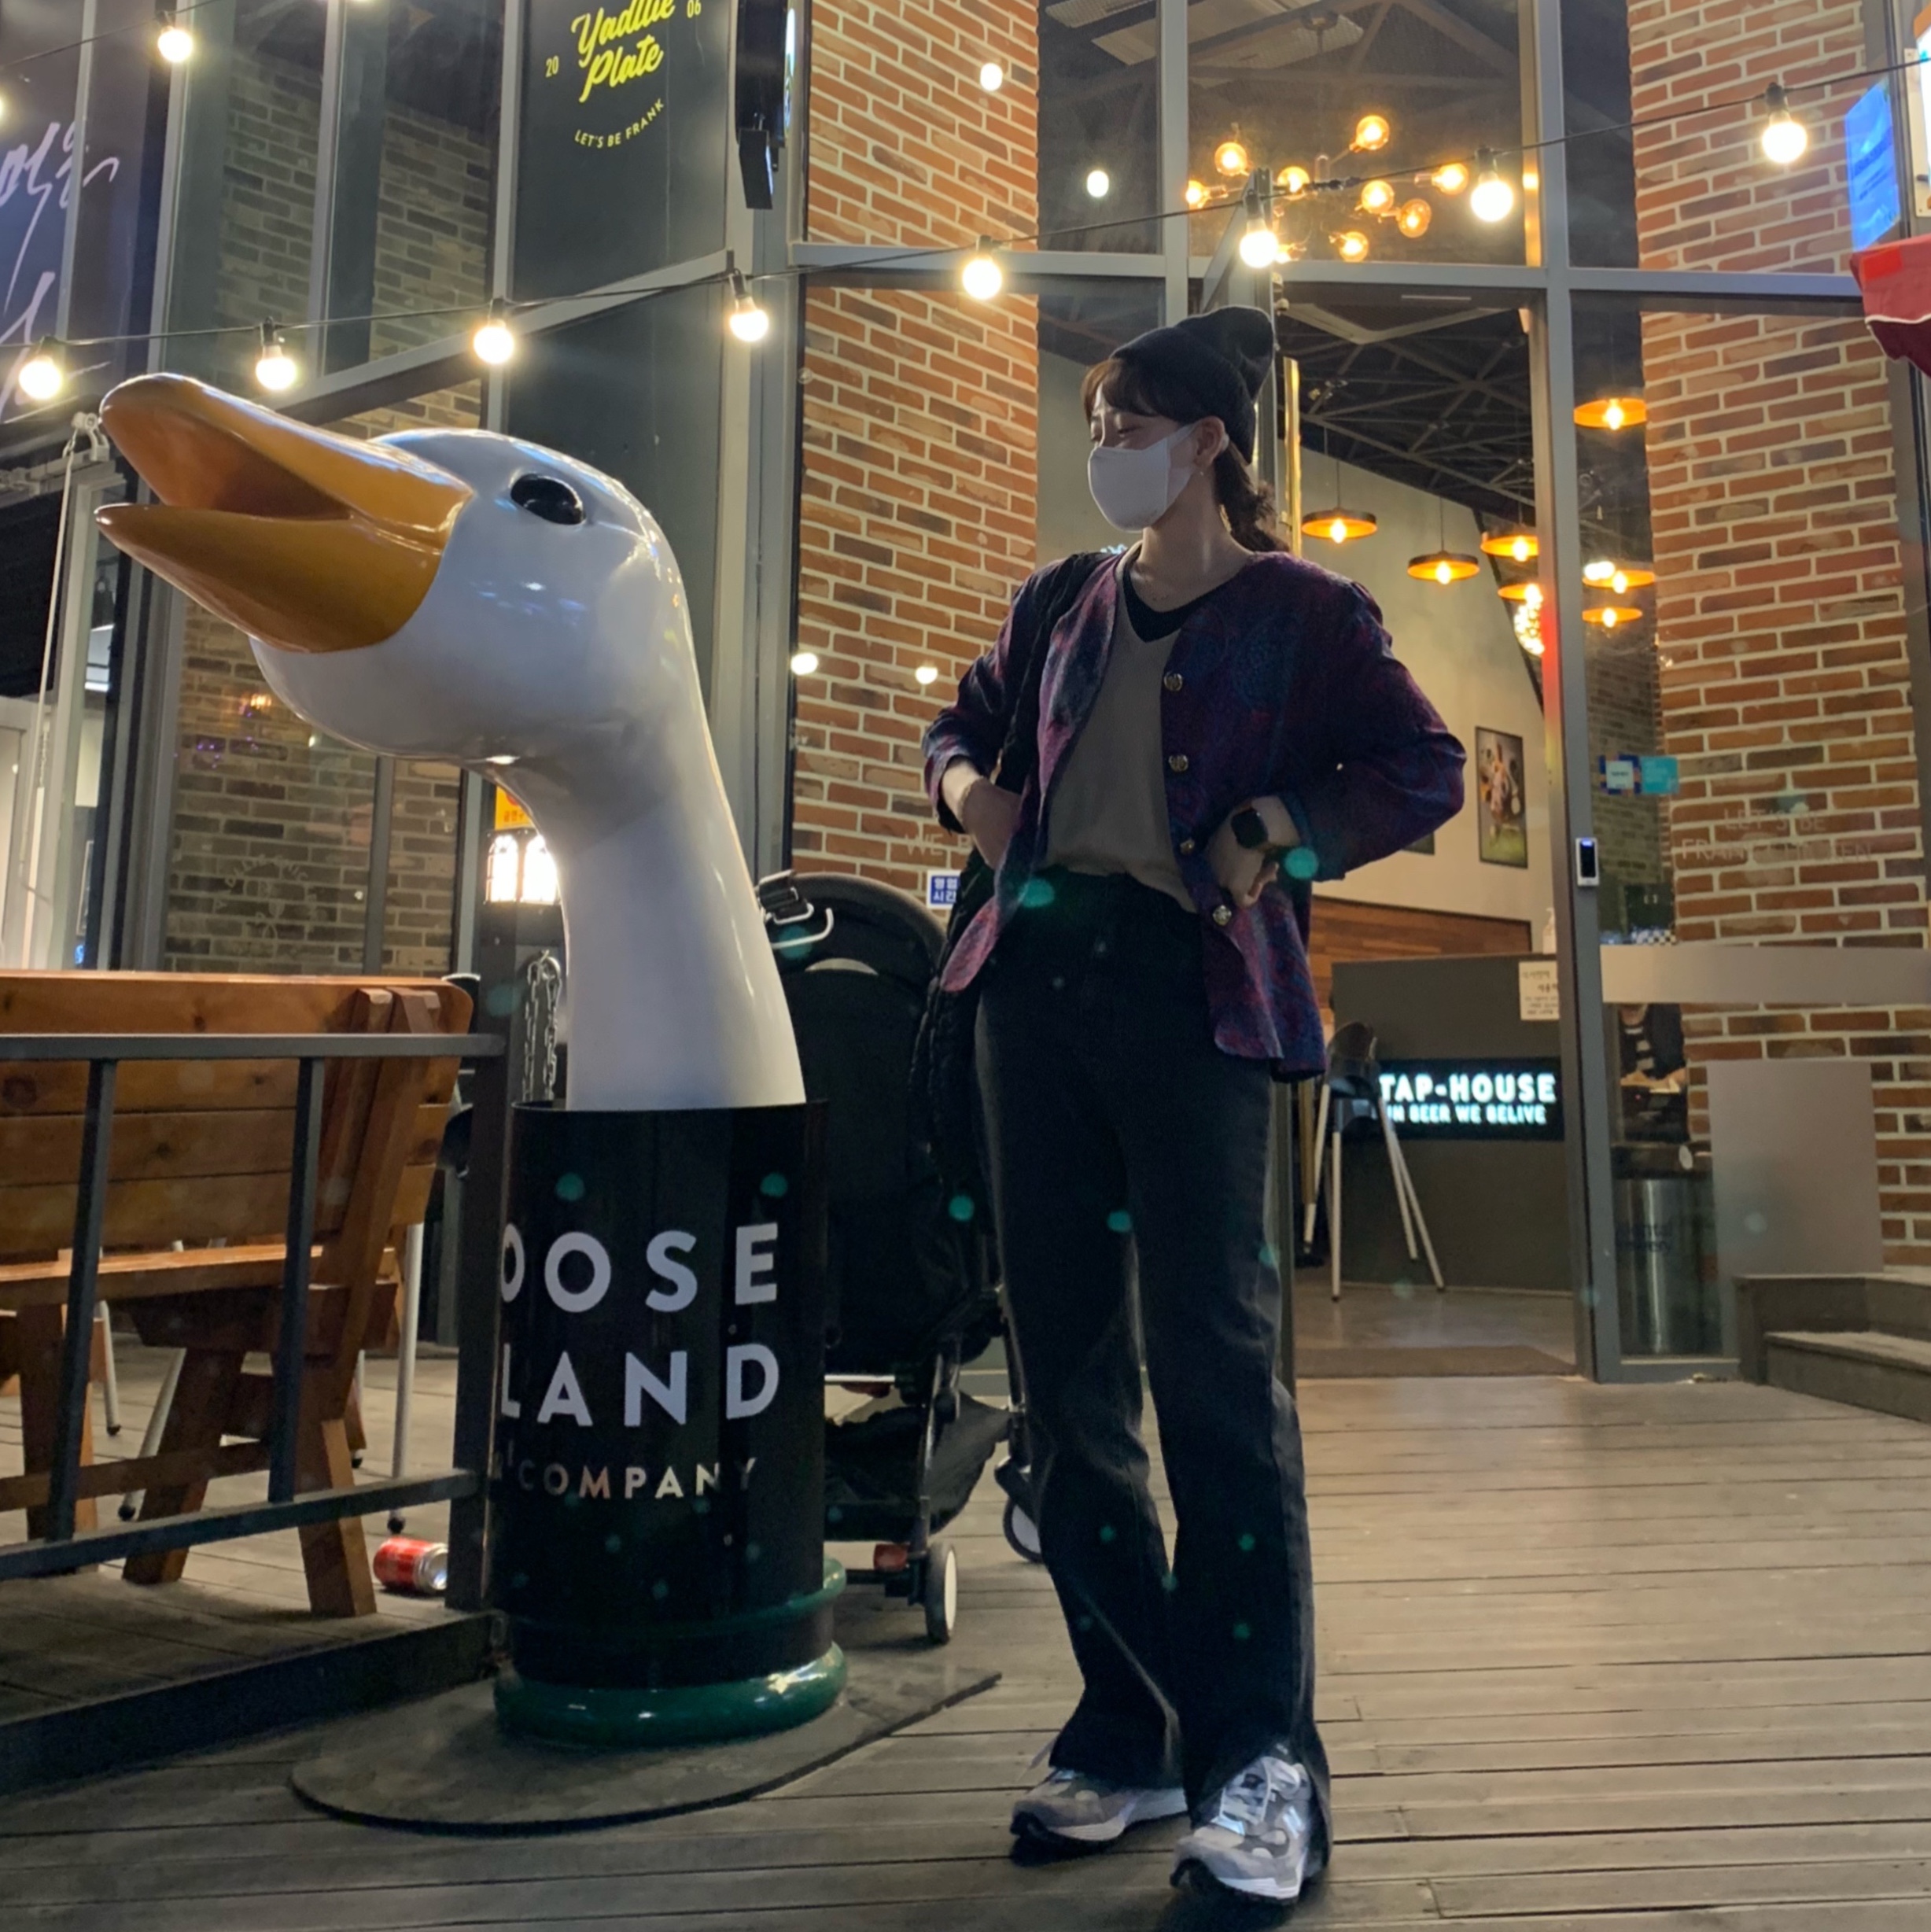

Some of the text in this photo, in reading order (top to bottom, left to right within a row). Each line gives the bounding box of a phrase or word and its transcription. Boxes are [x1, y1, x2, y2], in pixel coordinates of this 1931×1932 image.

[545, 55, 559, 78] 20
[578, 35, 664, 103] Plate
[574, 98, 664, 149] LET'S BE FRANK
[1378, 1073, 1557, 1103] TAP-HOUSE
[1455, 1104, 1482, 1123] WE
[518, 1458, 757, 1499] COMPANY
